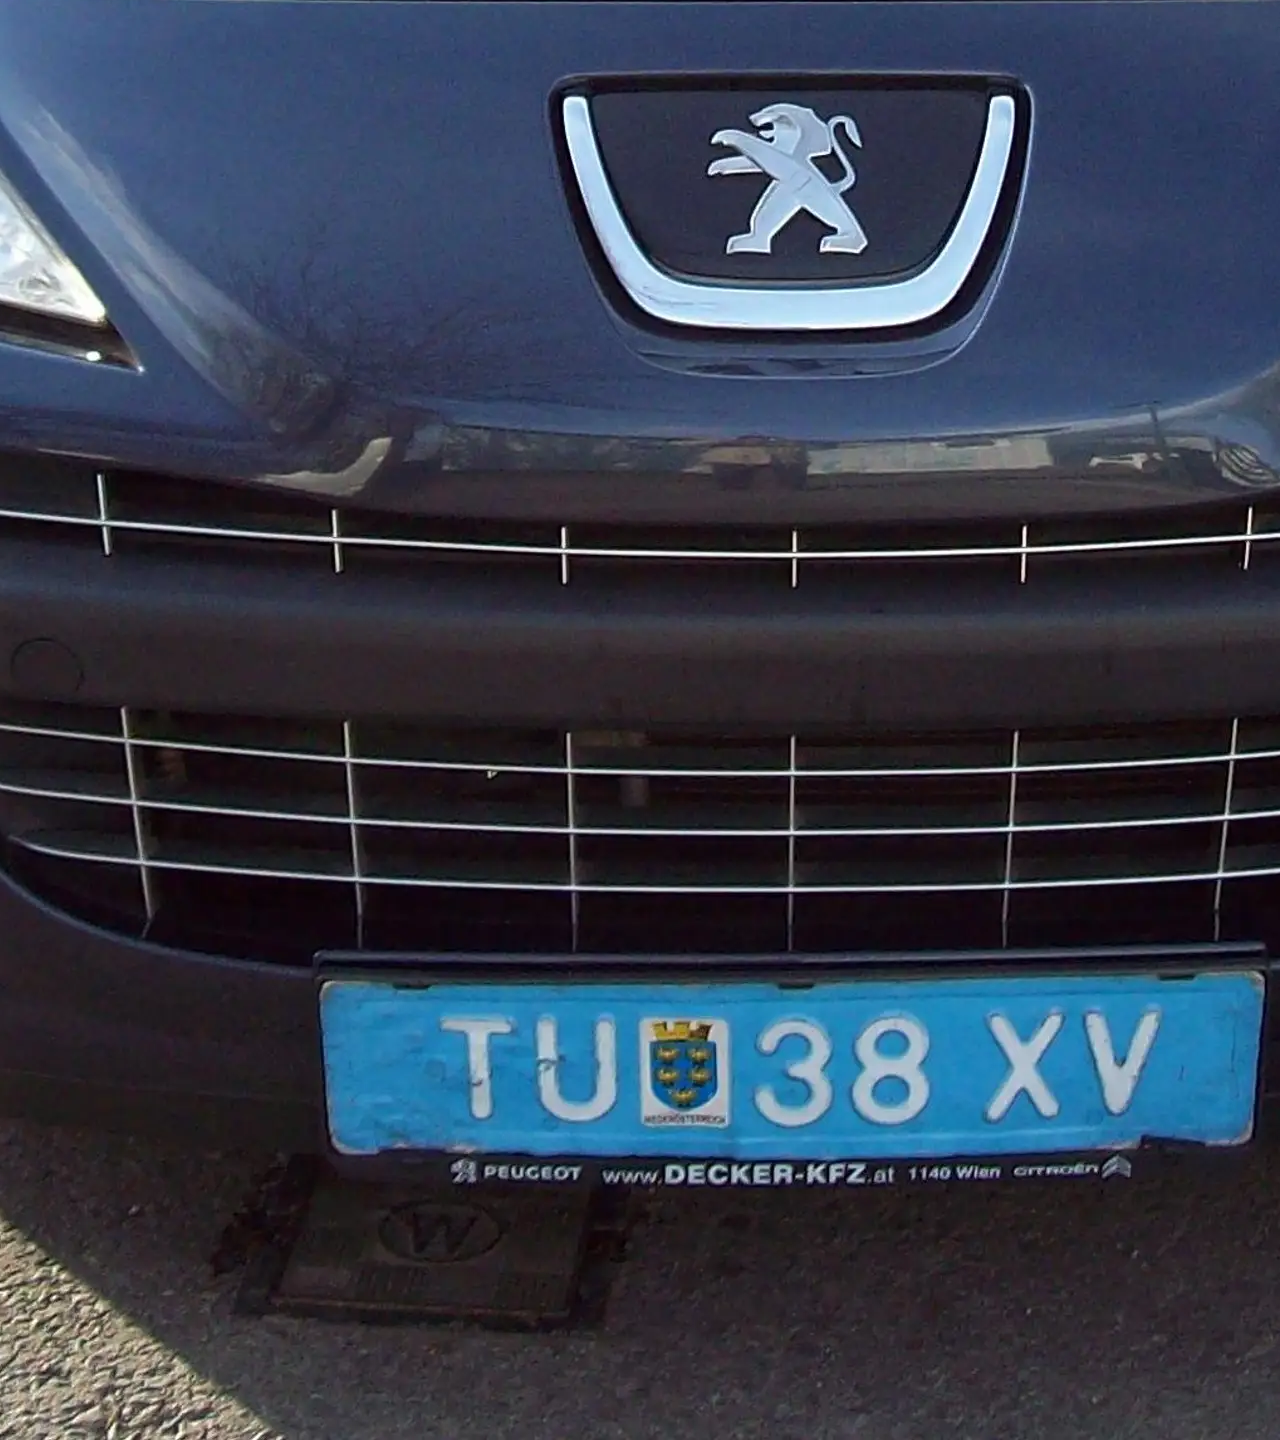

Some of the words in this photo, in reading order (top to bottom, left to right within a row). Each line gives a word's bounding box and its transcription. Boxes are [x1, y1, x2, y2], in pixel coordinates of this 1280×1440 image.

[440, 1015, 617, 1124] TU
[753, 1015, 932, 1128] 38
[983, 1010, 1162, 1124] XV
[483, 1164, 582, 1181] PEUGEOT
[602, 1163, 895, 1186] www.DECKER-KFZ.at
[908, 1165, 951, 1181] 1140
[956, 1165, 1001, 1180] Wien
